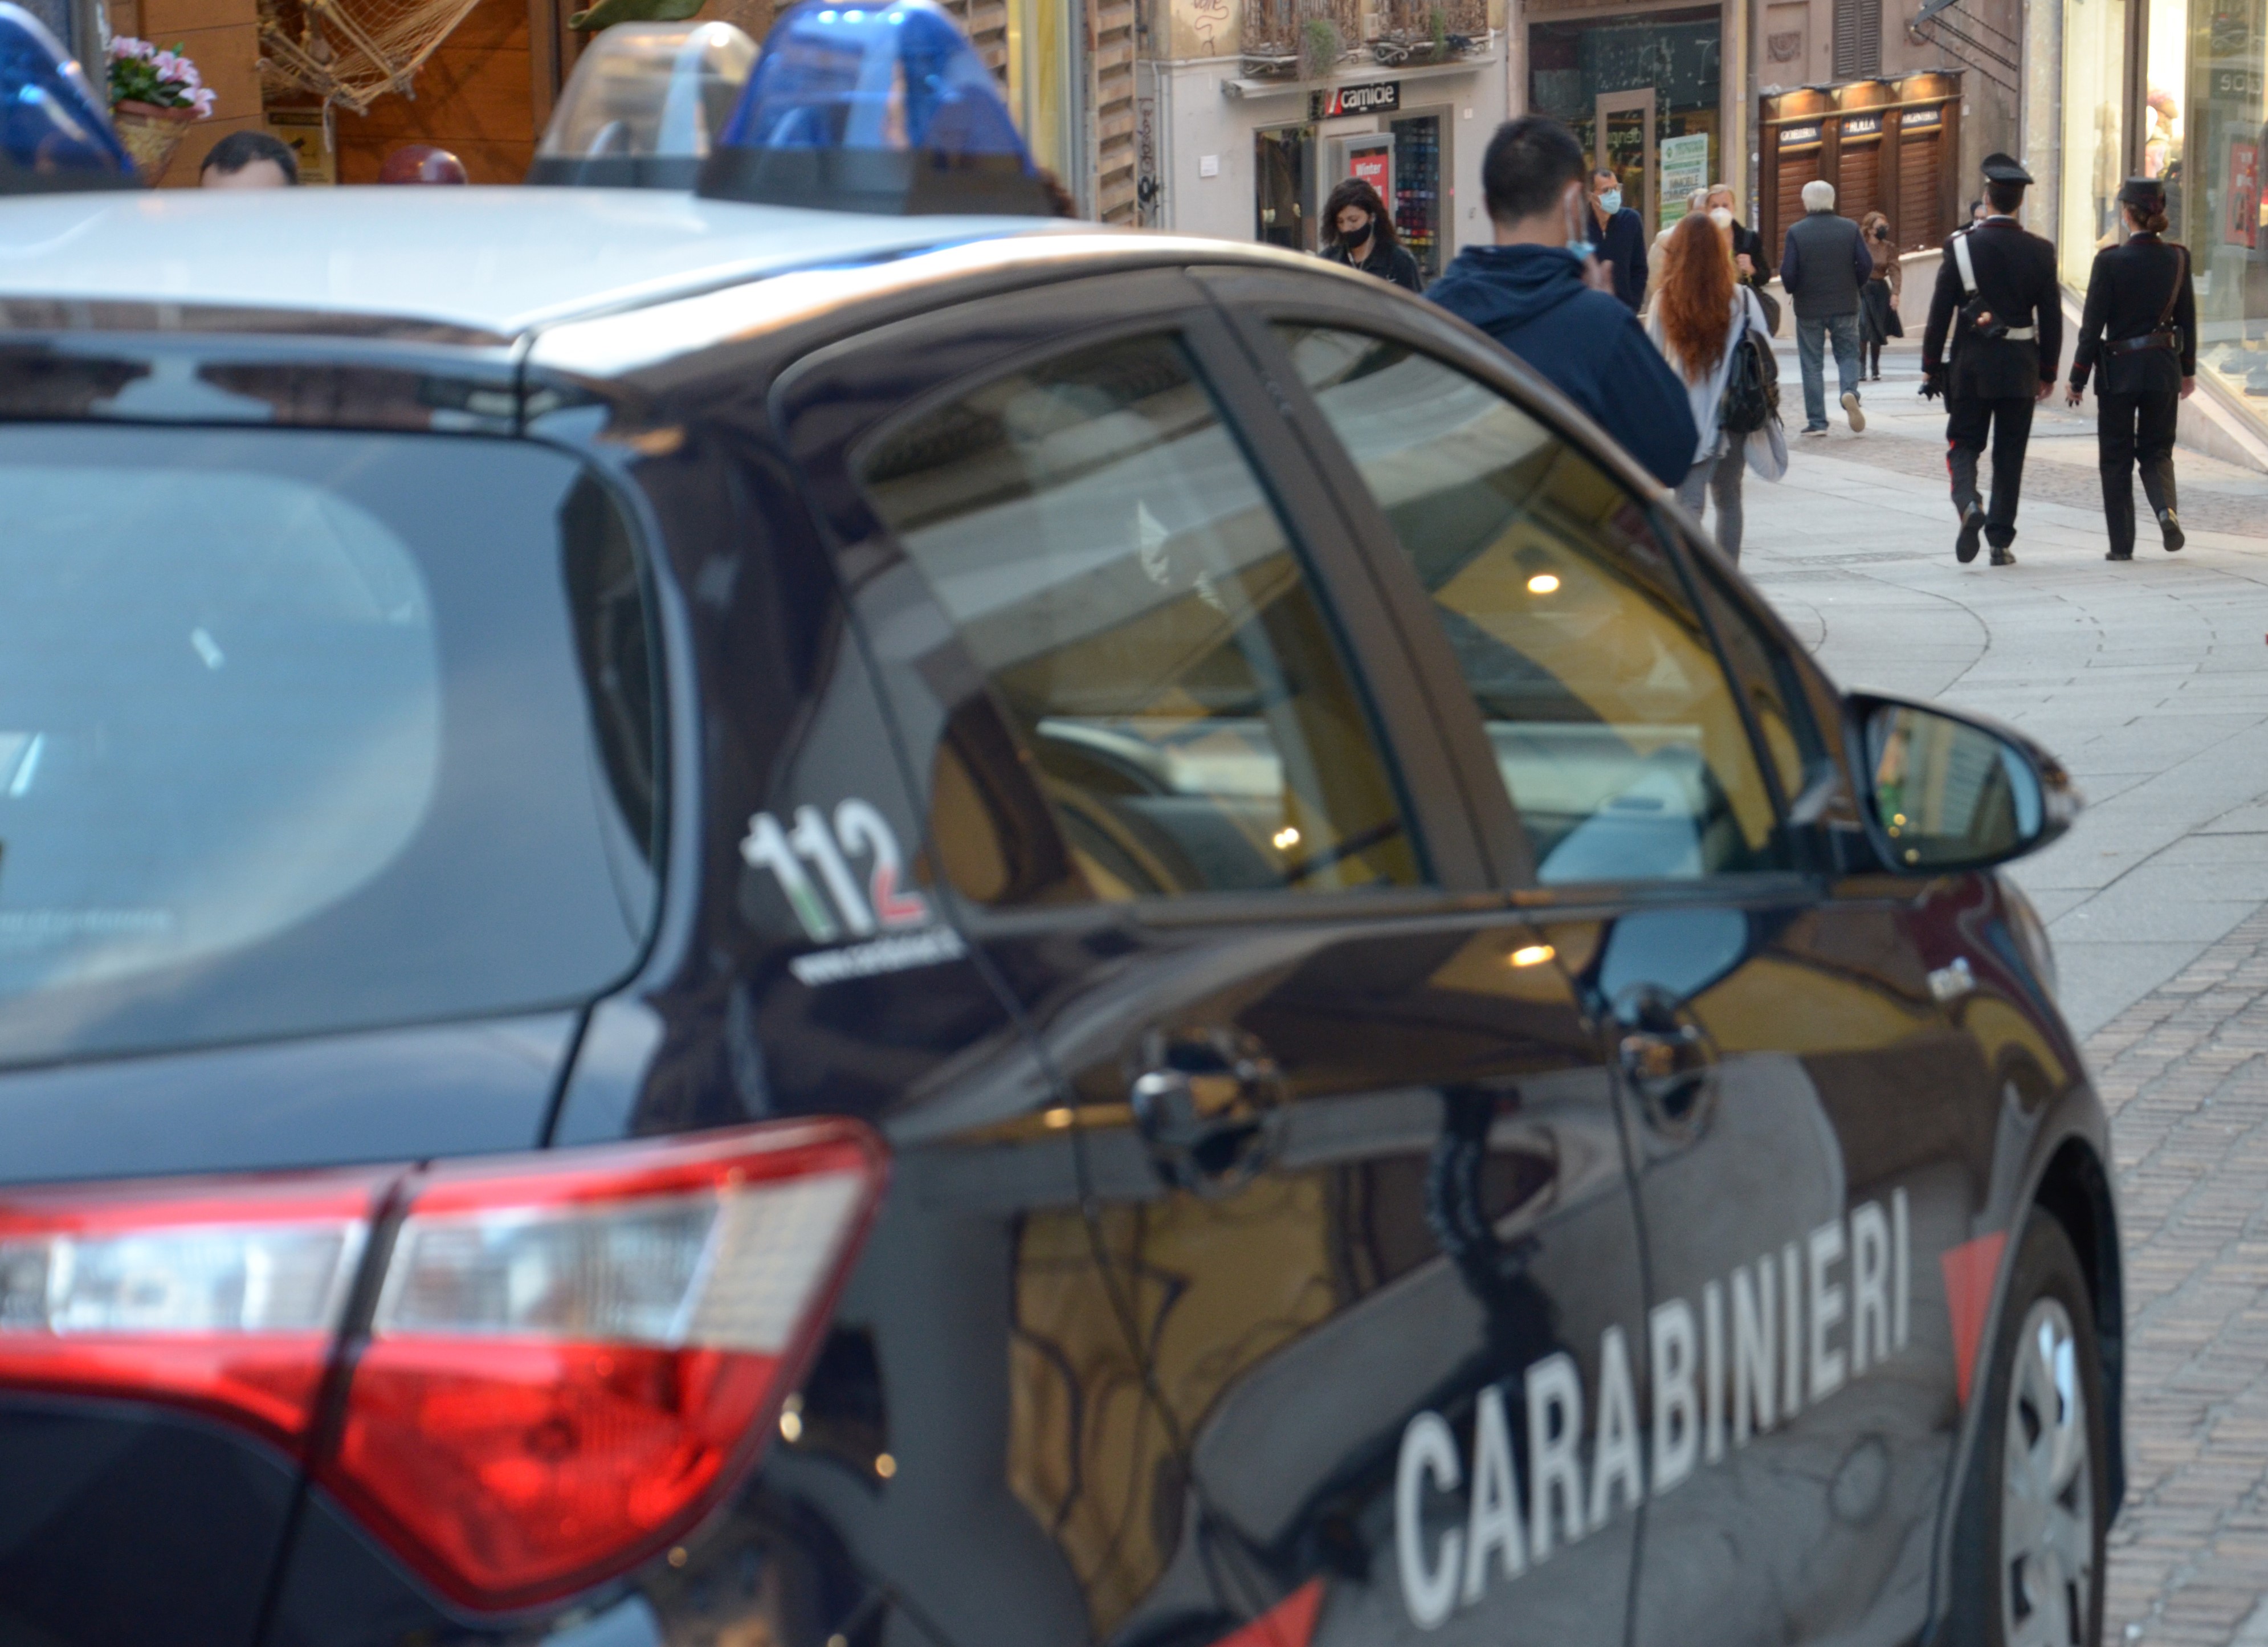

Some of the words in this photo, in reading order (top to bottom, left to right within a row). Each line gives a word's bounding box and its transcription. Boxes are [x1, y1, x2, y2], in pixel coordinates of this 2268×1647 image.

[1341, 82, 1394, 108] camicie
[1356, 163, 1381, 176] Winter
[740, 797, 930, 944] 112
[1396, 1188, 1910, 1630] CARABINIERI
